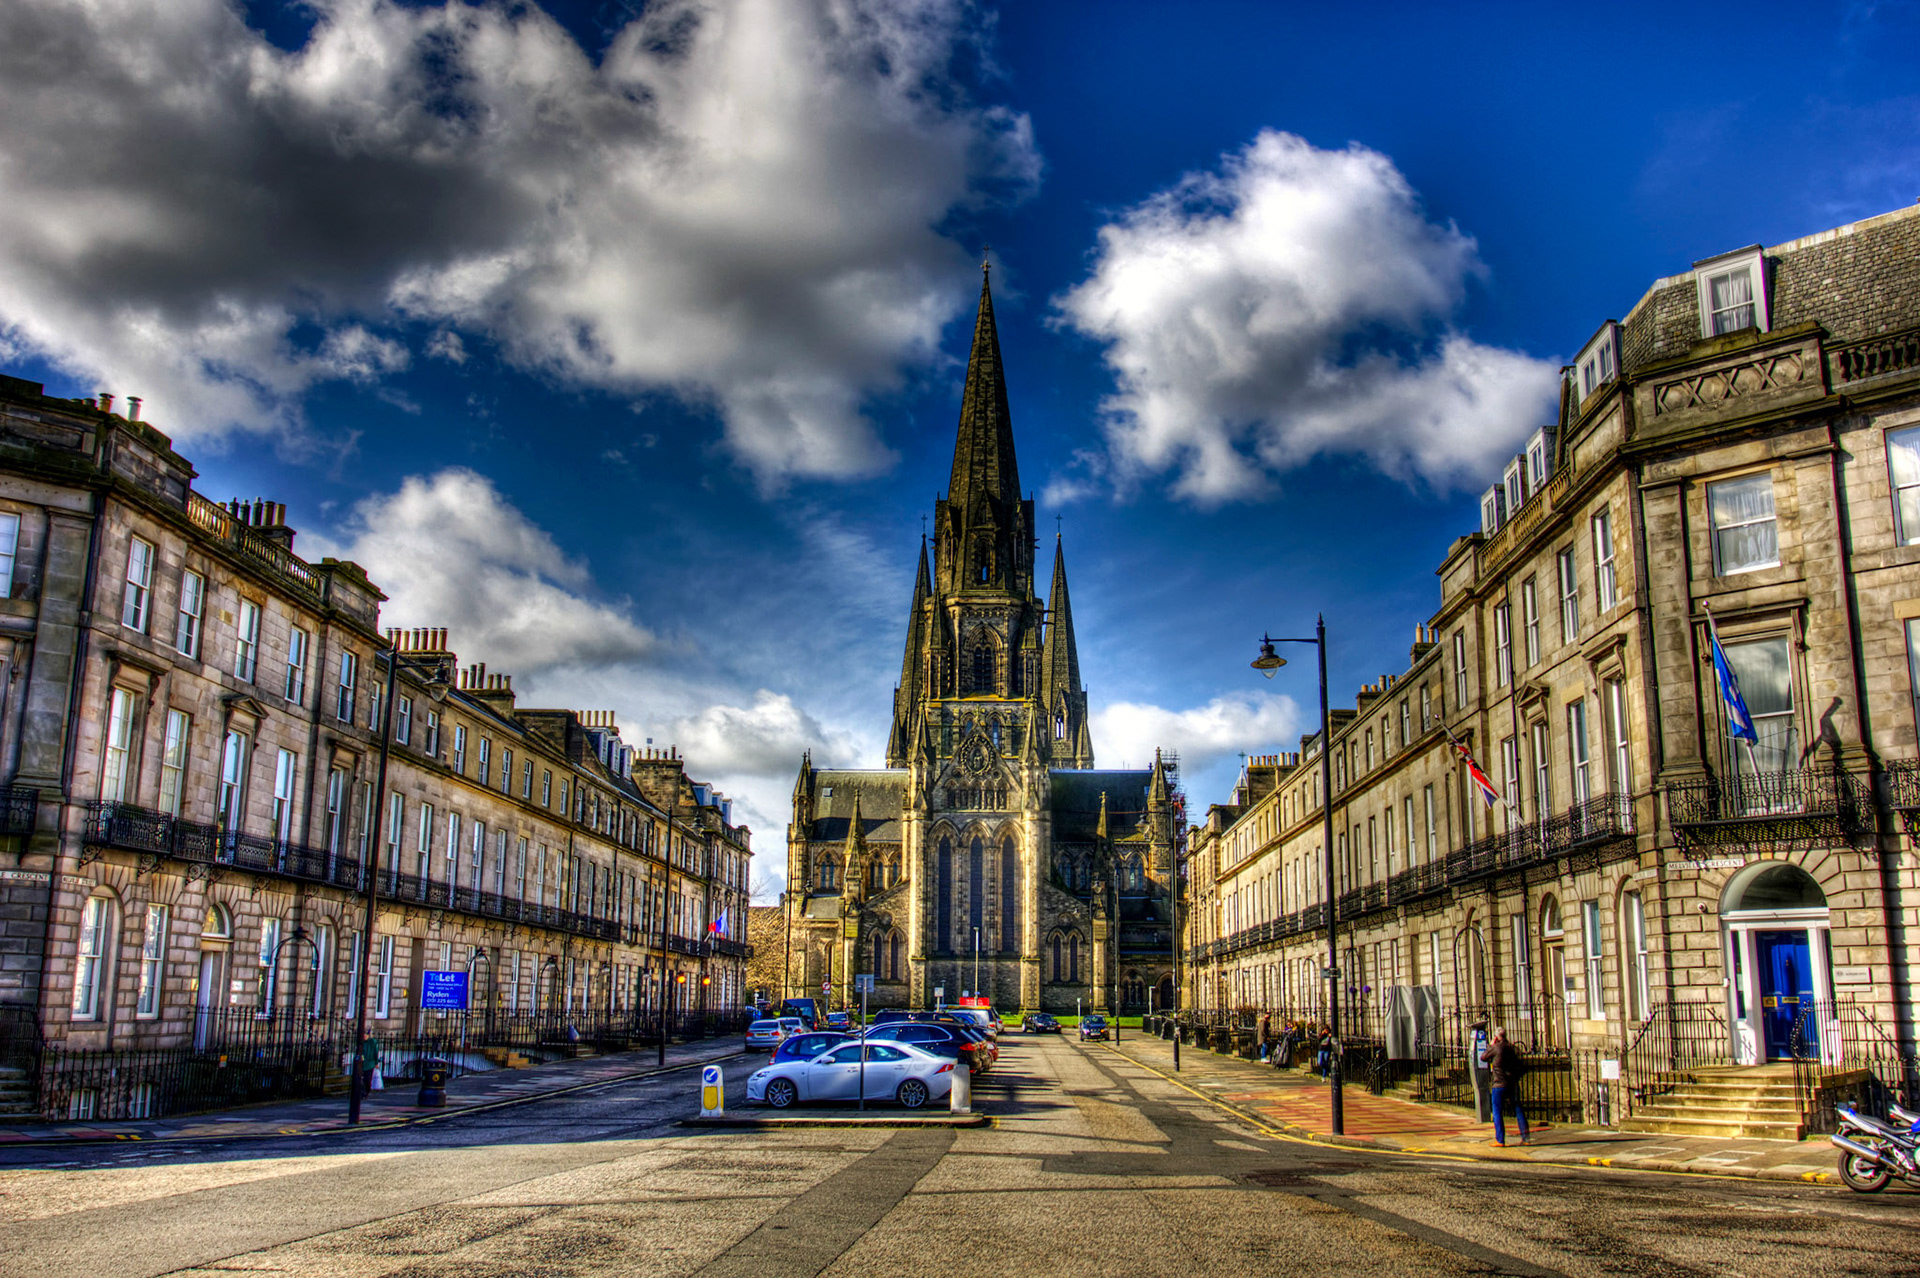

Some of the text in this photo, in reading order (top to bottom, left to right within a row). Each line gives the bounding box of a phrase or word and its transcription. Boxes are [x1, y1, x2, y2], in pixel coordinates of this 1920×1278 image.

[1668, 859, 1742, 870] MELVILL CRESCENT
[11, 872, 49, 881] CRESCENT
